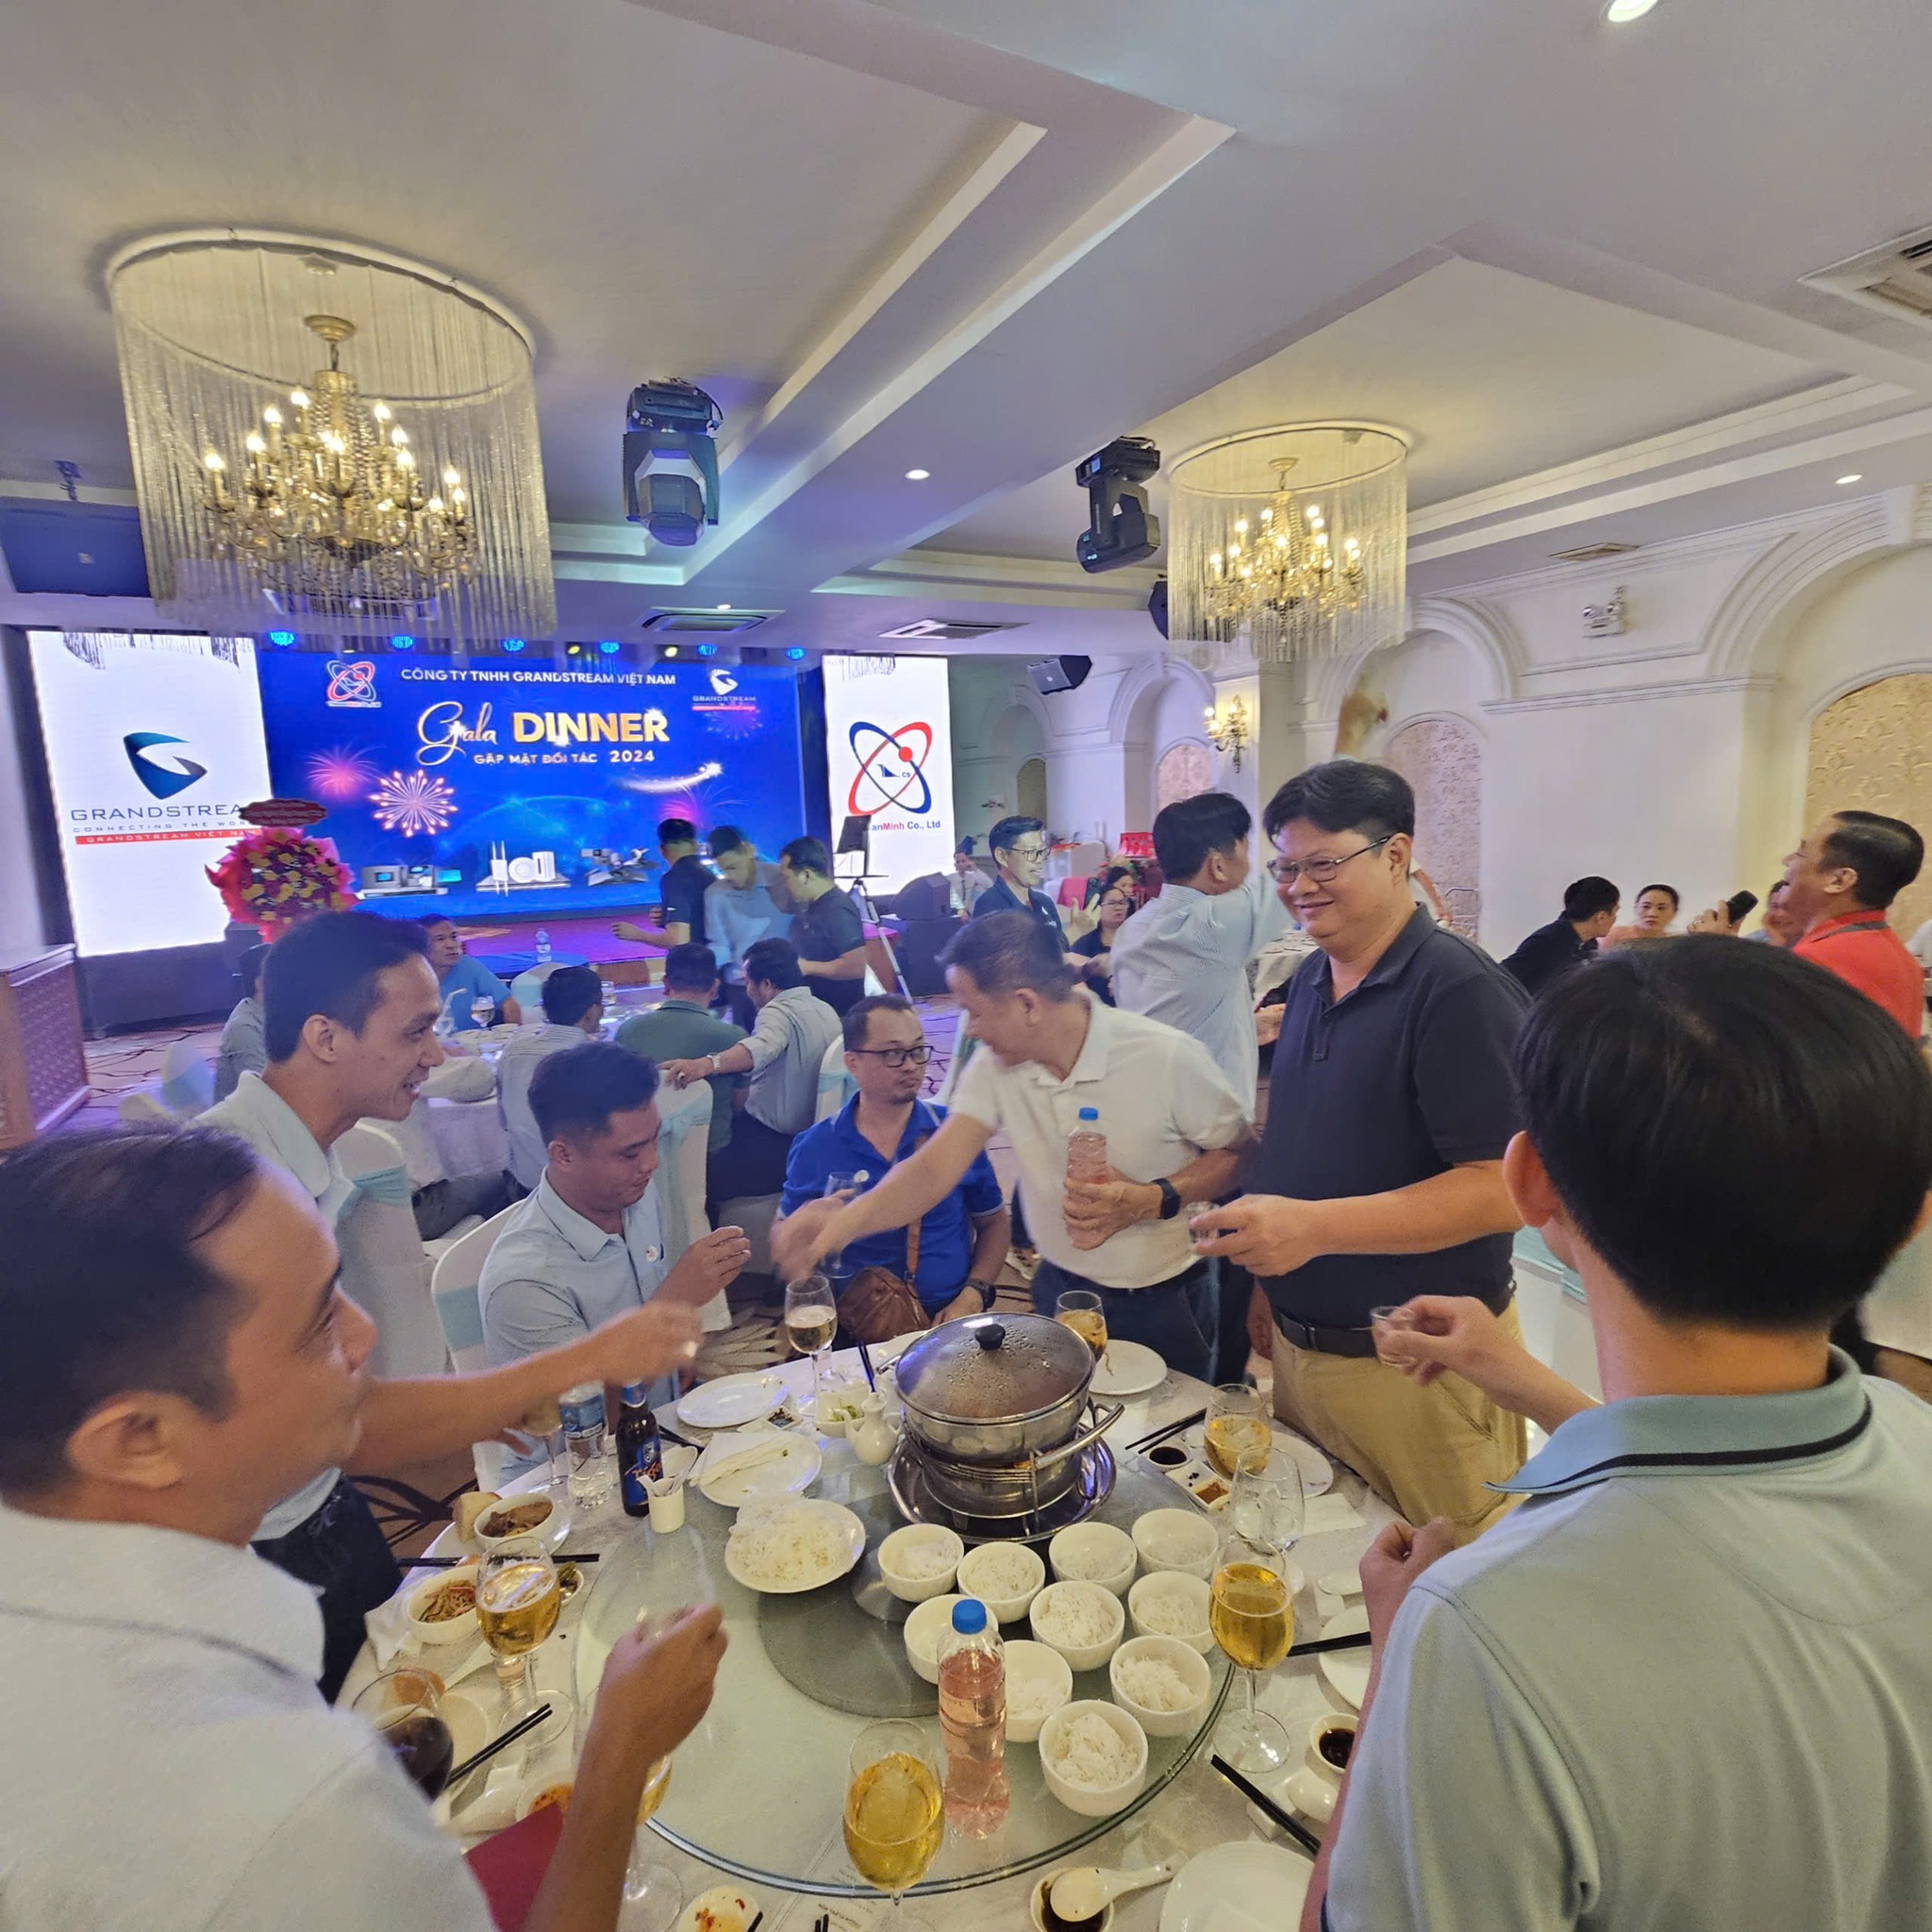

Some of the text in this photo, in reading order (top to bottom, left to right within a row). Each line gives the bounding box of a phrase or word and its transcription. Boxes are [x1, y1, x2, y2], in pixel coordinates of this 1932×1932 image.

[401, 667, 676, 687] CÔNG TY TNHH GRANDSTREAM VIỆT NAM
[416, 701, 671, 766] Gala DINNER
[571, 752, 598, 763] TÁC
[609, 750, 655, 763] 2024
[71, 804, 242, 821] GRANDSTREA
[73, 823, 172, 832] CONNECTING
[907, 821, 924, 830] Co.,
[926, 820, 941, 828] Ltd
[87, 833, 188, 842] GRANDSTREAM
